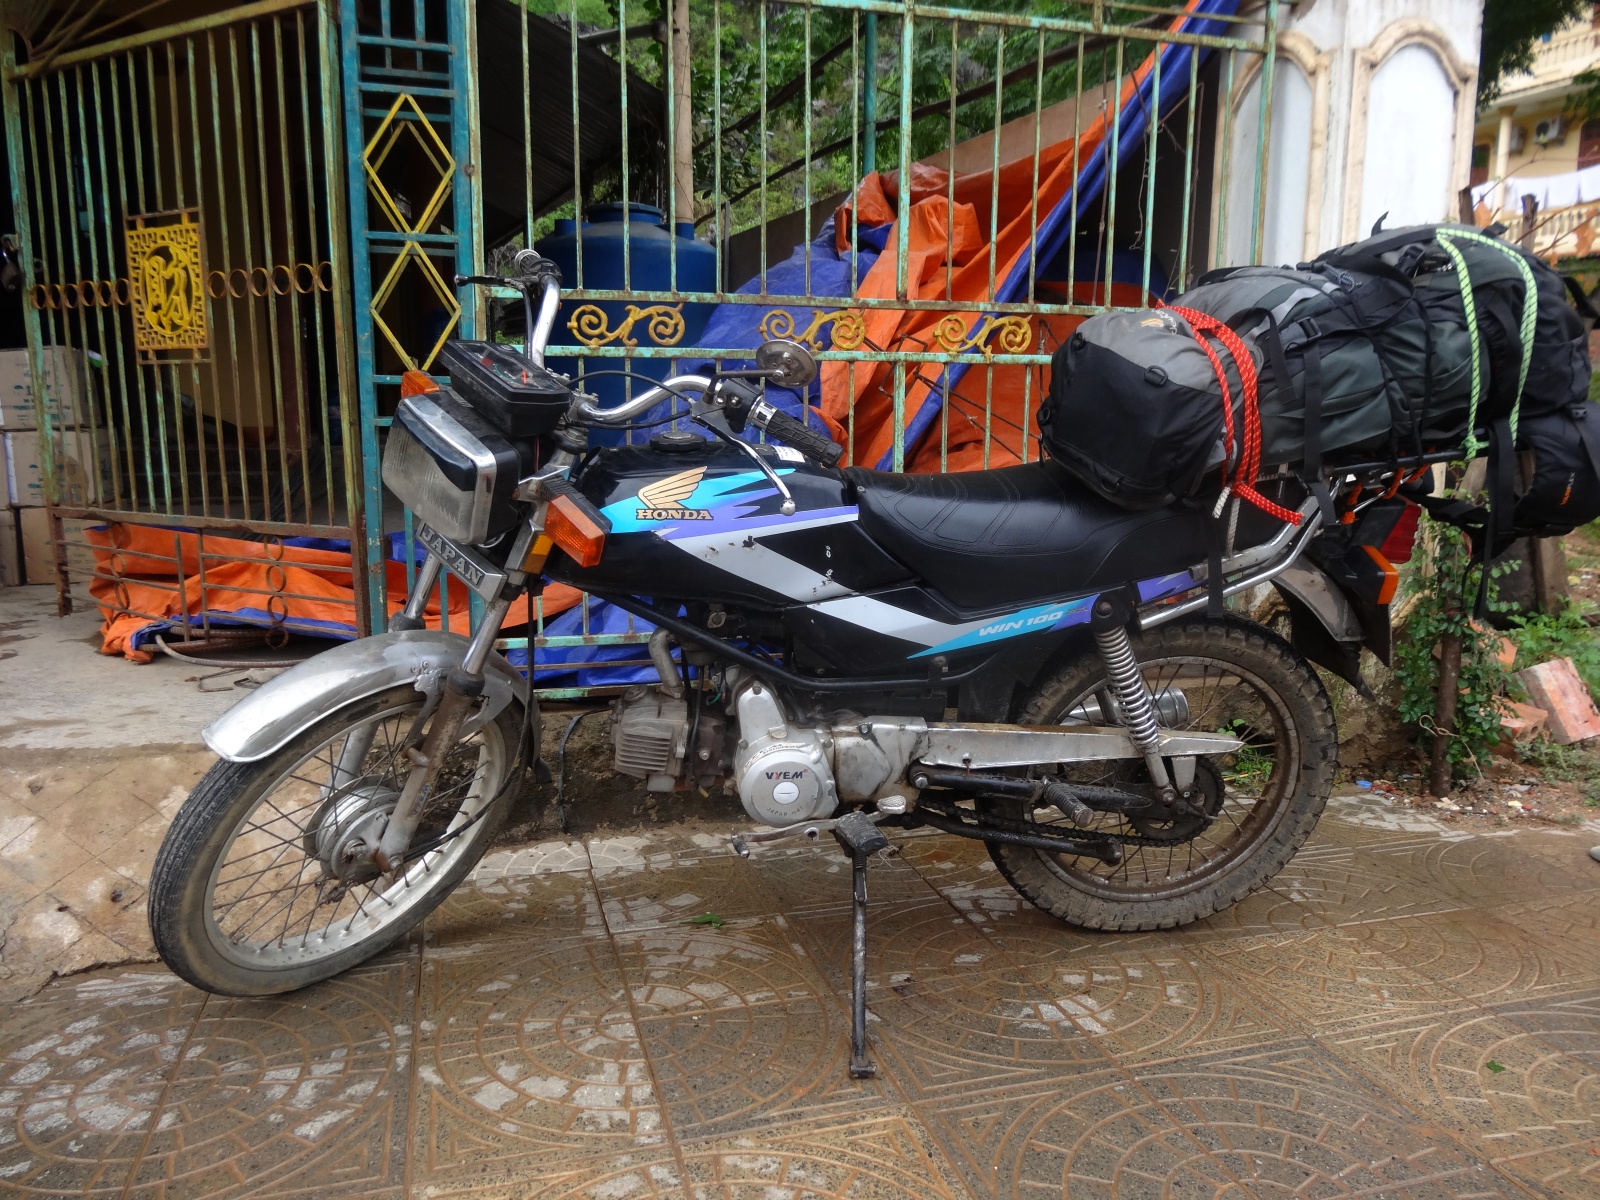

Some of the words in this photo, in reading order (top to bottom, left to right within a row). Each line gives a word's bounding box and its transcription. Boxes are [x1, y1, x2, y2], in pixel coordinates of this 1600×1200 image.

[636, 508, 714, 521] HONDA
[420, 527, 484, 586] JAPAN
[978, 619, 1025, 637] WIN
[1026, 610, 1064, 626] 100
[765, 770, 804, 781] VYEM
[766, 807, 788, 817] JAPAN
